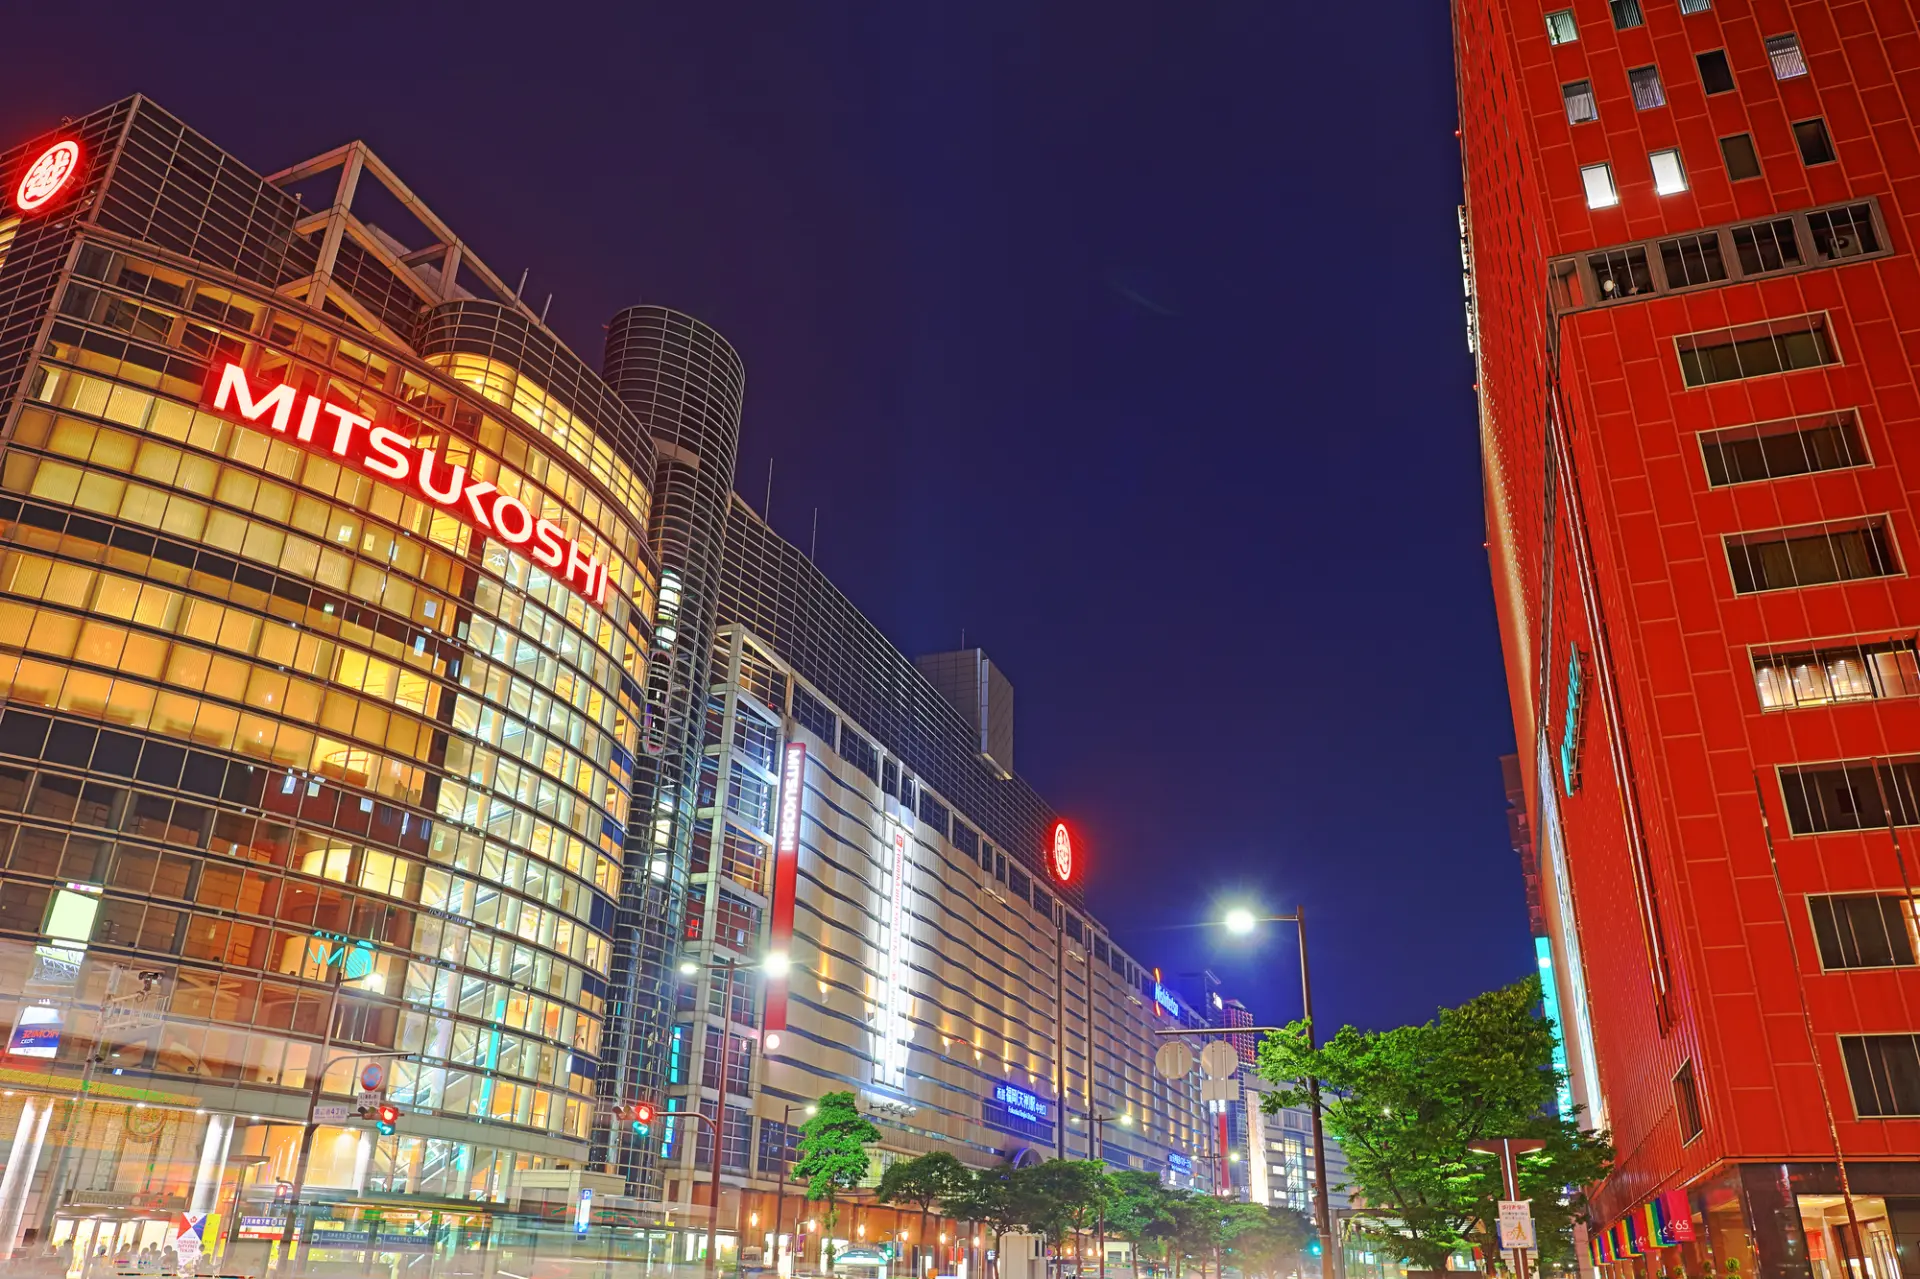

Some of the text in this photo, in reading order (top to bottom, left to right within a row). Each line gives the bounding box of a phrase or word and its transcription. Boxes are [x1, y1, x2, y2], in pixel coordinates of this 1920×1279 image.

[213, 363, 608, 605] MITSUKOSHI
[781, 749, 800, 851] MITSUKOSHI
[584, 1191, 590, 1199] P
[1675, 1220, 1689, 1230] 65
